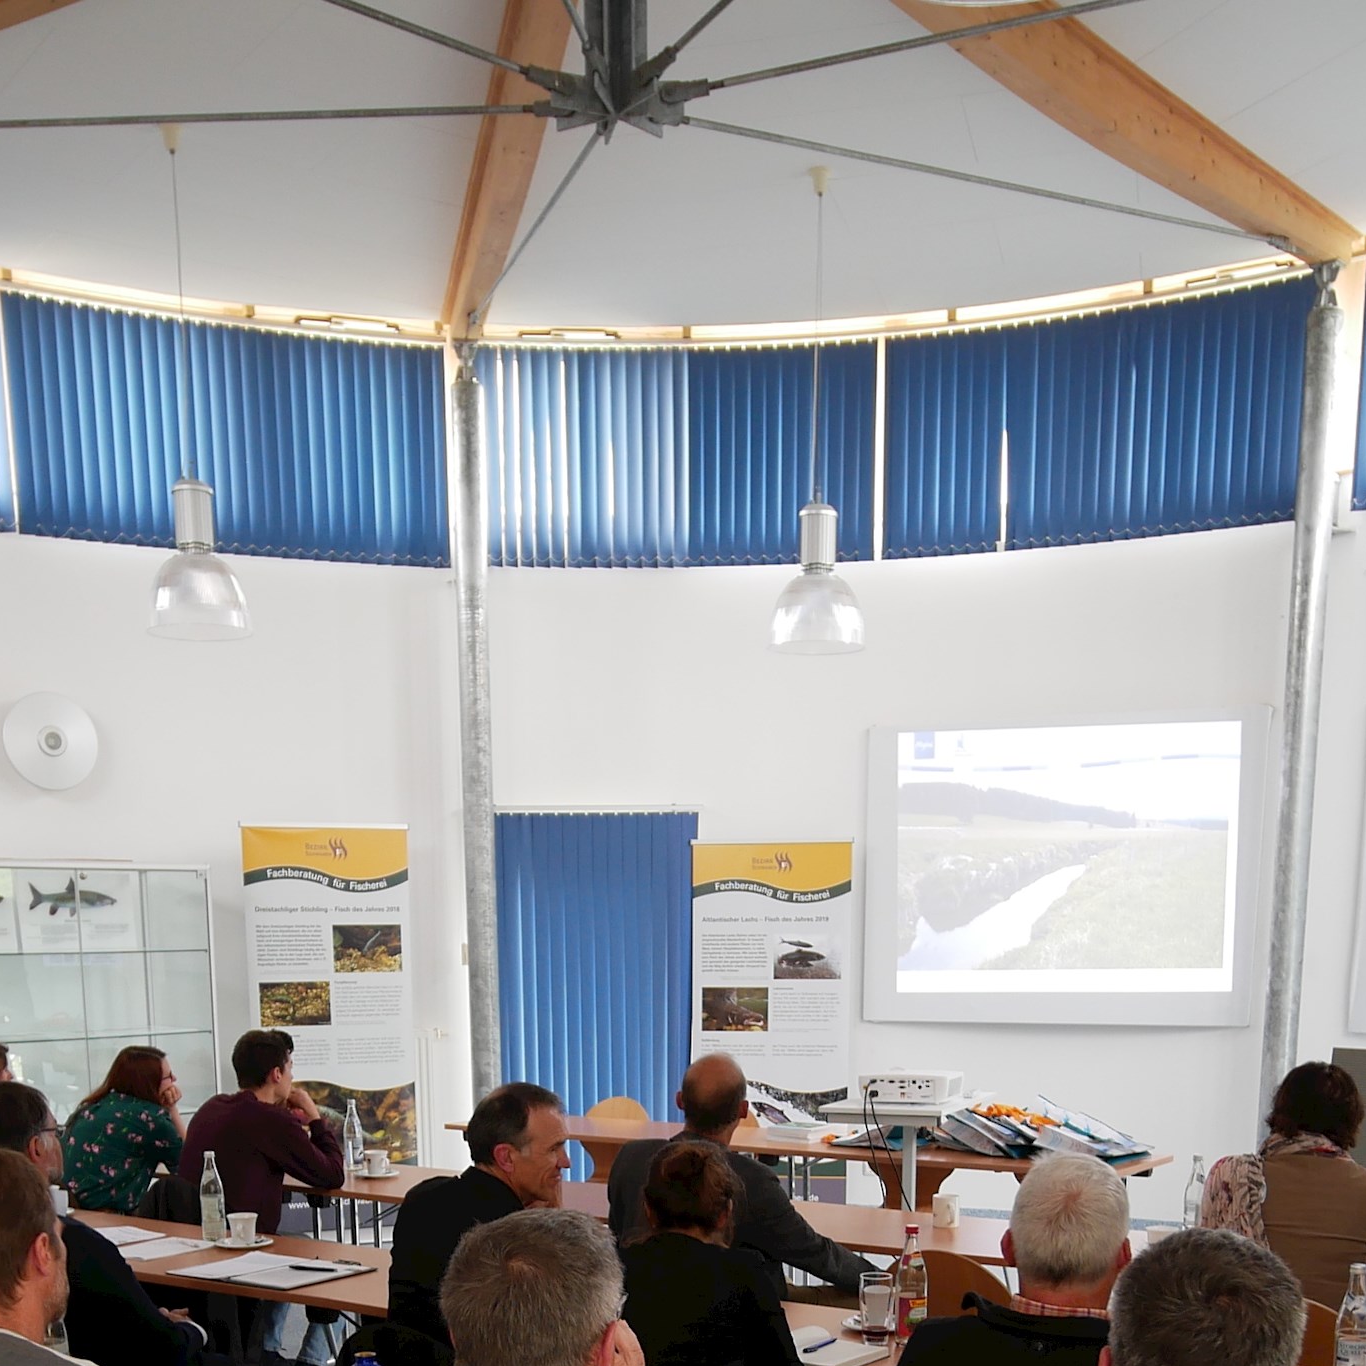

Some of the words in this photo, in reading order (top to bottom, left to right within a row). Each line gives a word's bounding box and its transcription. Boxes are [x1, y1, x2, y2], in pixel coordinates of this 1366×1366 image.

[266, 868, 329, 886] Fachberatung
[332, 878, 346, 889] für
[349, 878, 388, 891] Fischerei
[714, 881, 774, 897] Fachberatung
[776, 890, 790, 900] für
[792, 890, 830, 902] Fischerei
